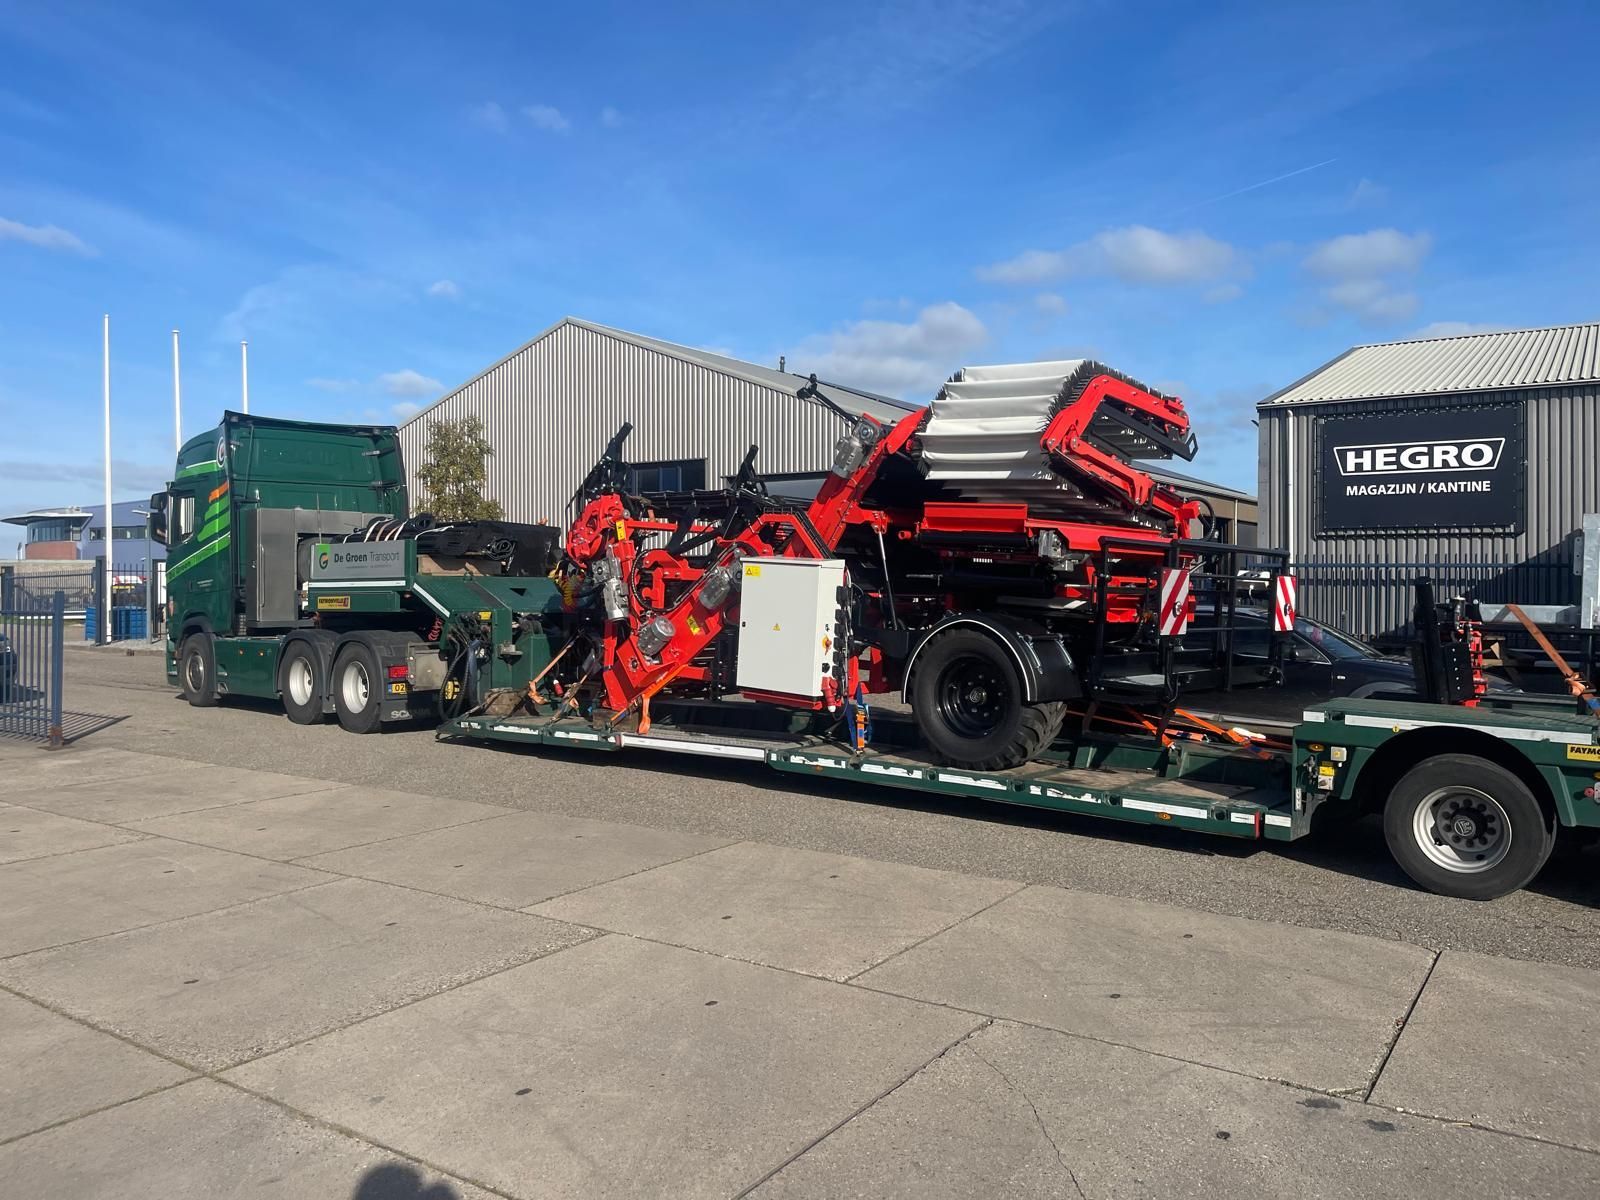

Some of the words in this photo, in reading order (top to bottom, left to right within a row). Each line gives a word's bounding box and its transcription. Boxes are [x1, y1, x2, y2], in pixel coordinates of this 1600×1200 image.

[1346, 443, 1494, 472] HEGRO
[1346, 483, 1417, 497] MAGAZIJN
[1427, 480, 1491, 494] KANTINE
[334, 553, 344, 563] De
[345, 552, 368, 562] Groen
[370, 551, 399, 563] Transport
